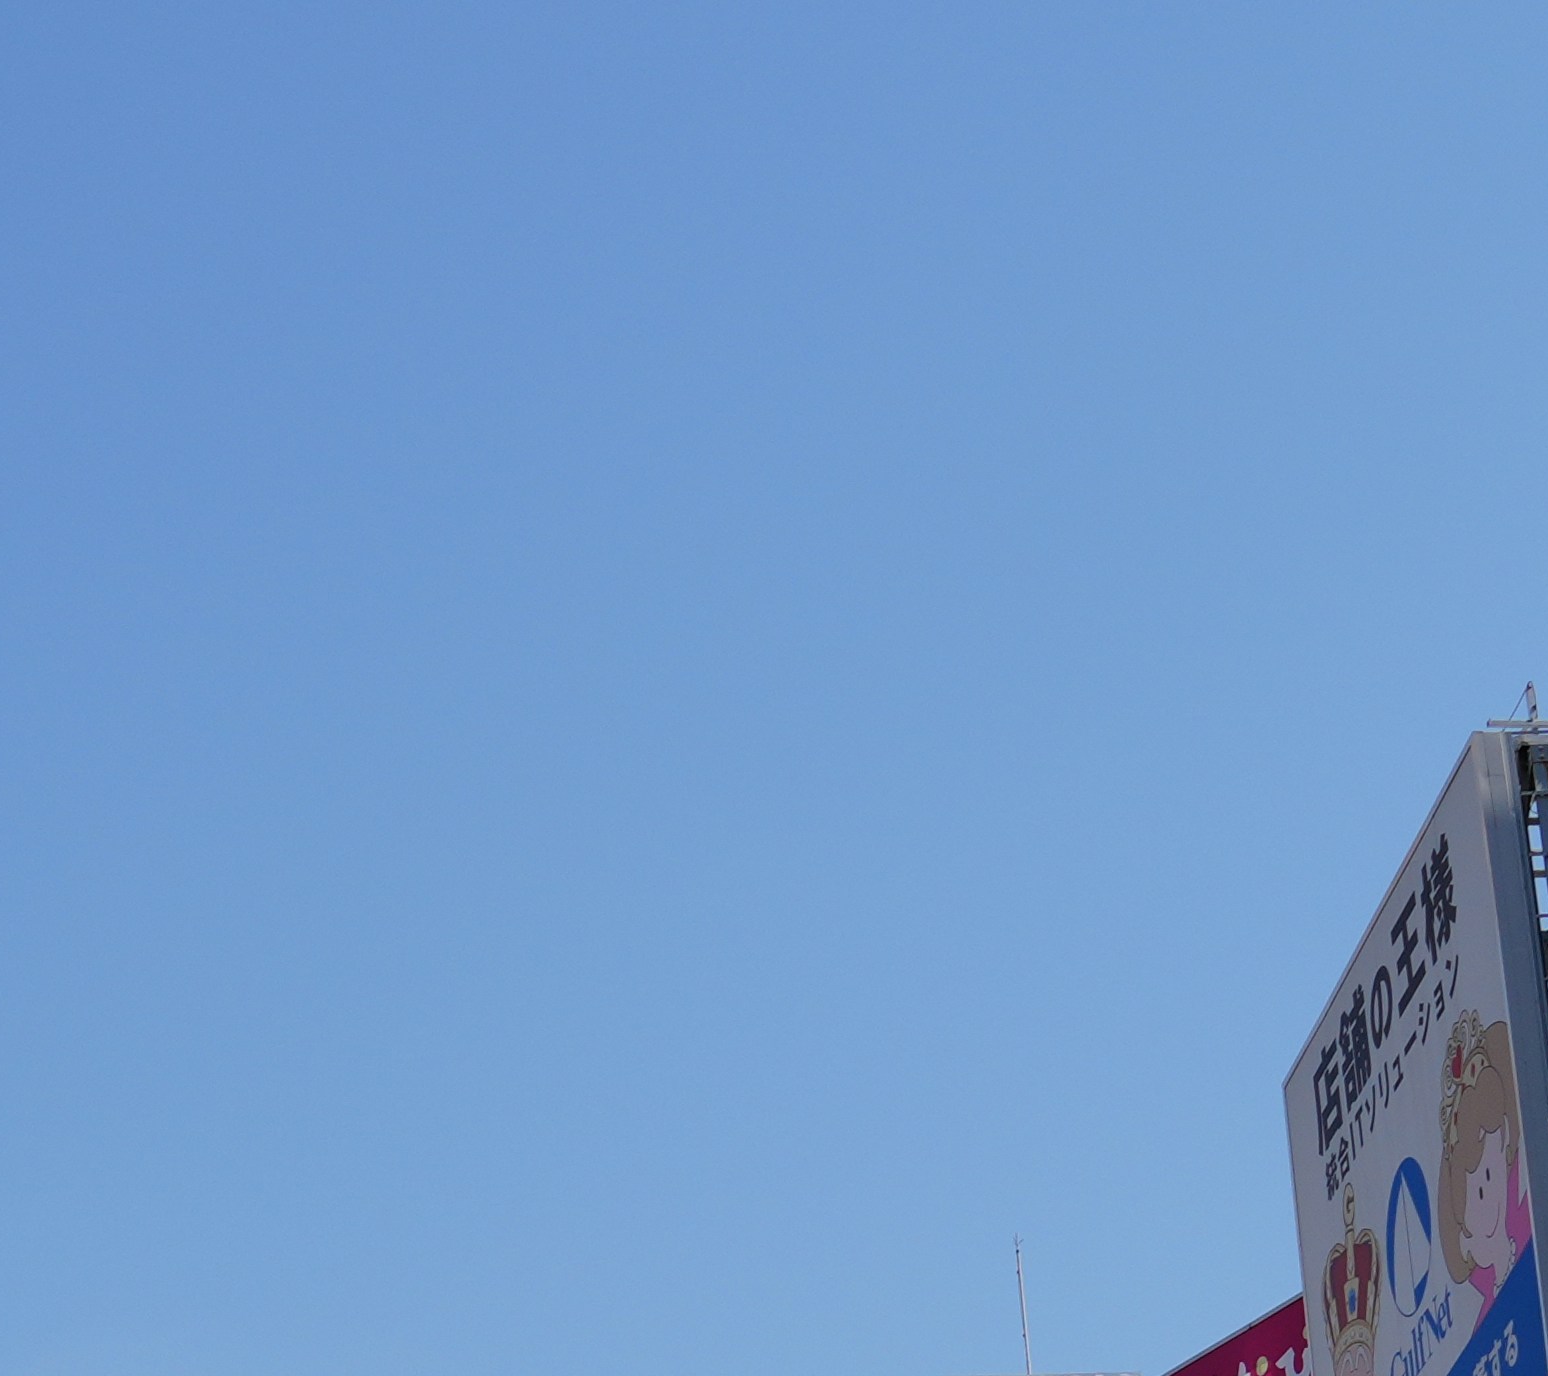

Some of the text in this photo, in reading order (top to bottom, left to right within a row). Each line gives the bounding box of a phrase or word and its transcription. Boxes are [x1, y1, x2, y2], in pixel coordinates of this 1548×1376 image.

[1312, 832, 1458, 1156] 店舗の王様
[1325, 951, 1461, 1202] 統合ITソリューション
